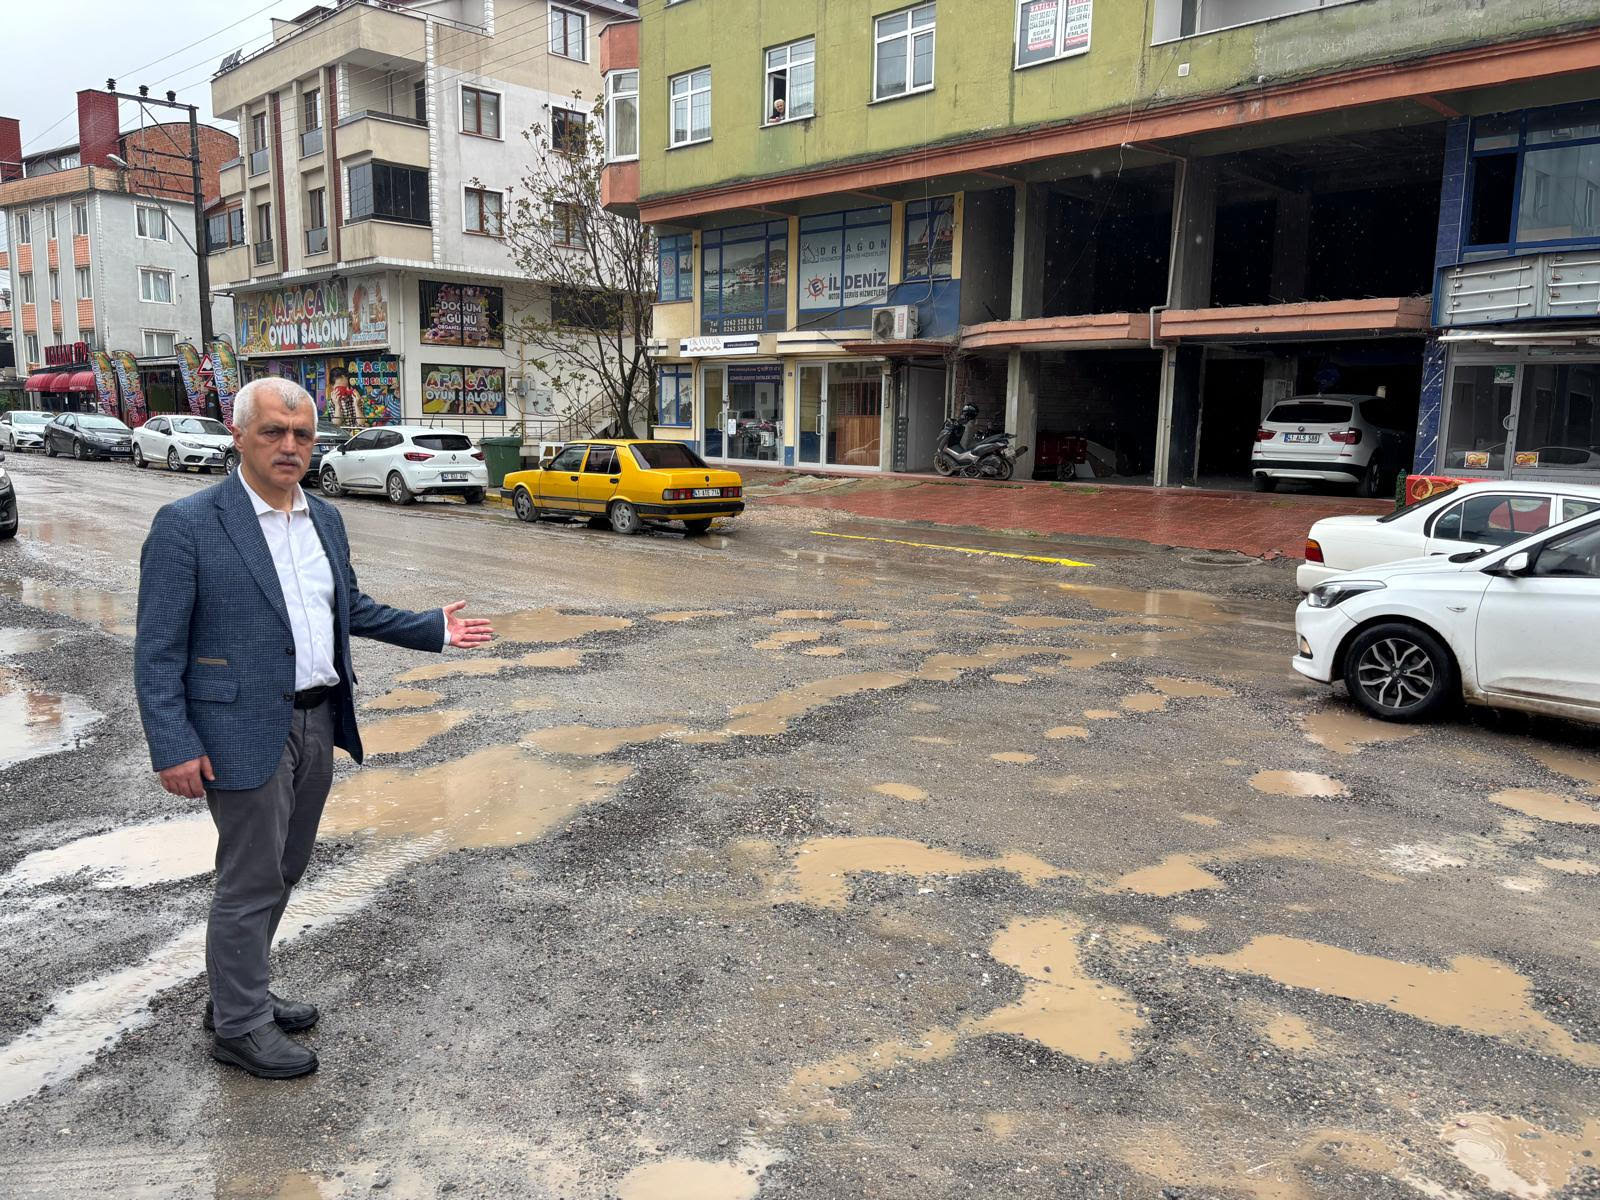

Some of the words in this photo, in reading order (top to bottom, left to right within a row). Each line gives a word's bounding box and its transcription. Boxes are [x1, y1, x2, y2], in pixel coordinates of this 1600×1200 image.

[820, 239, 887, 256] DRAGON
[274, 284, 339, 324] AFACAN
[446, 311, 477, 325] GÜNÜ
[268, 322, 298, 346] OYUN
[301, 317, 347, 344] SALONU
[349, 361, 397, 372] AFACAN
[349, 377, 369, 386] OYUN
[426, 372, 502, 390] AFACAN
[426, 391, 455, 401] OYUN
